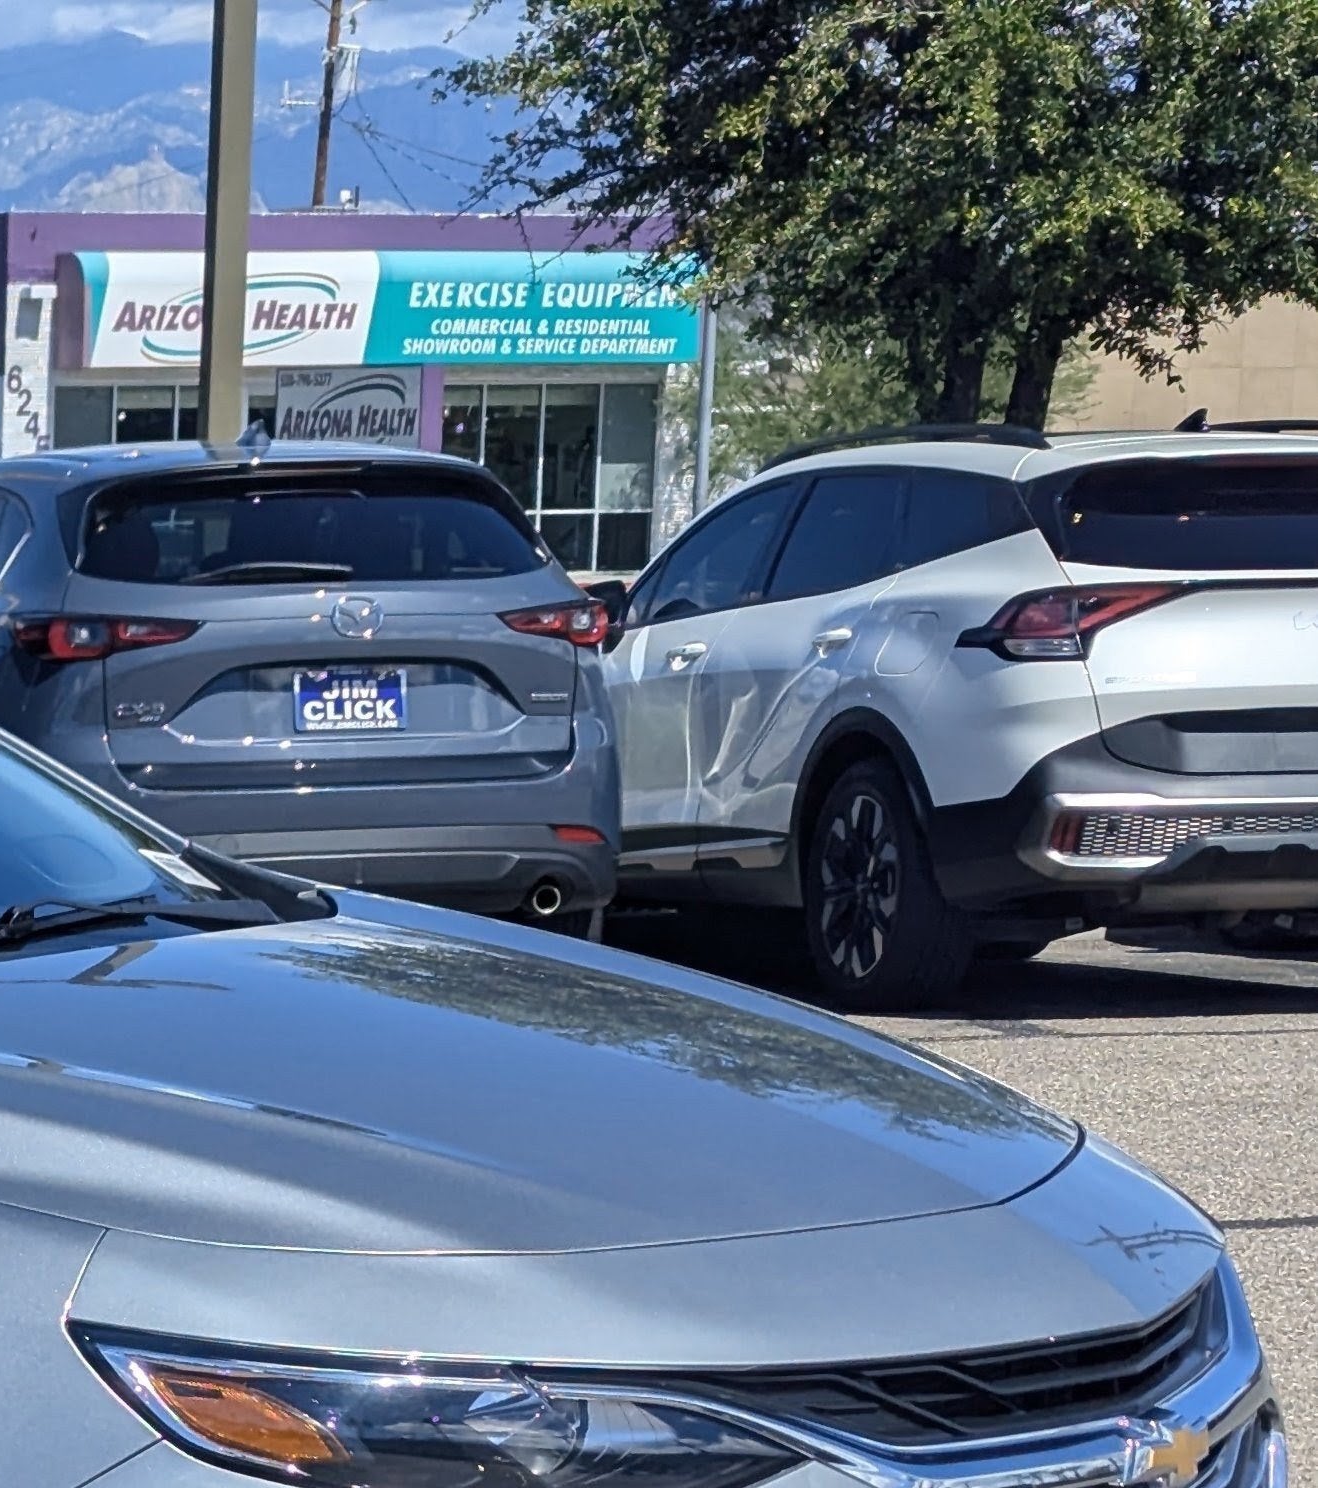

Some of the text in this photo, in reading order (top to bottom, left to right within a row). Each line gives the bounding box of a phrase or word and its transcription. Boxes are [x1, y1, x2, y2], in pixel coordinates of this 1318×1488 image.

[409, 281, 528, 308] EXERCISE
[112, 300, 357, 332] ARIZO HEALTH
[431, 318, 651, 335] COMMERCIAL & RESIDENTIAL
[402, 337, 678, 355] SHOWROOM & SERVICE DEPARTMENT
[279, 405, 417, 440] ARIZONA HEALTH
[323, 680, 378, 699] JIM
[304, 699, 396, 720] CLICK
